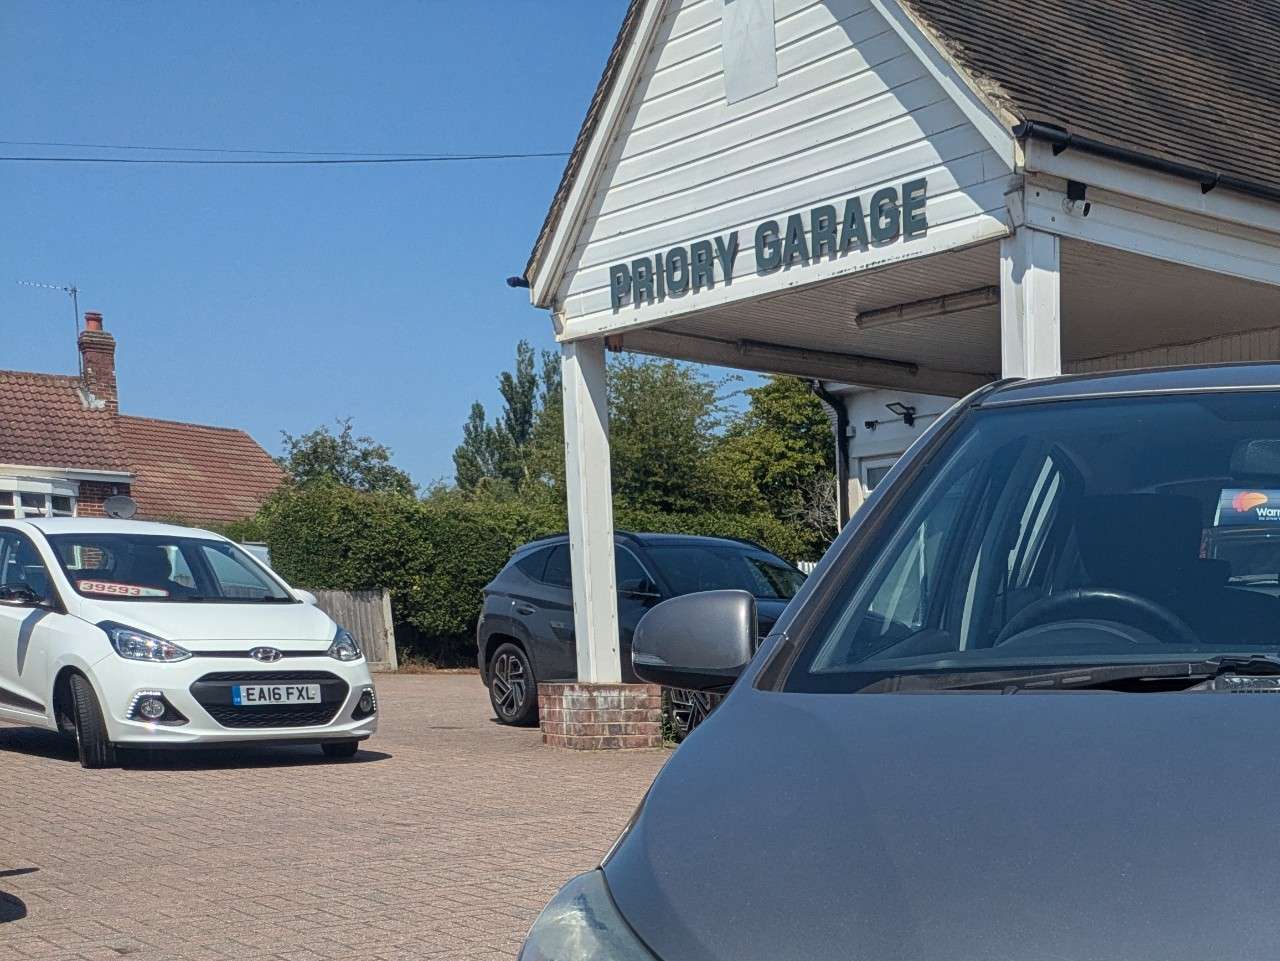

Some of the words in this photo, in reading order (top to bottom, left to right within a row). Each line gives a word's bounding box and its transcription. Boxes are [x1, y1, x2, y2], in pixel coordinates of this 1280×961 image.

[610, 230, 738, 314] PRIORY
[755, 177, 928, 277] GARAGE
[246, 687, 282, 702] EA16
[286, 686, 315, 701] FXL
